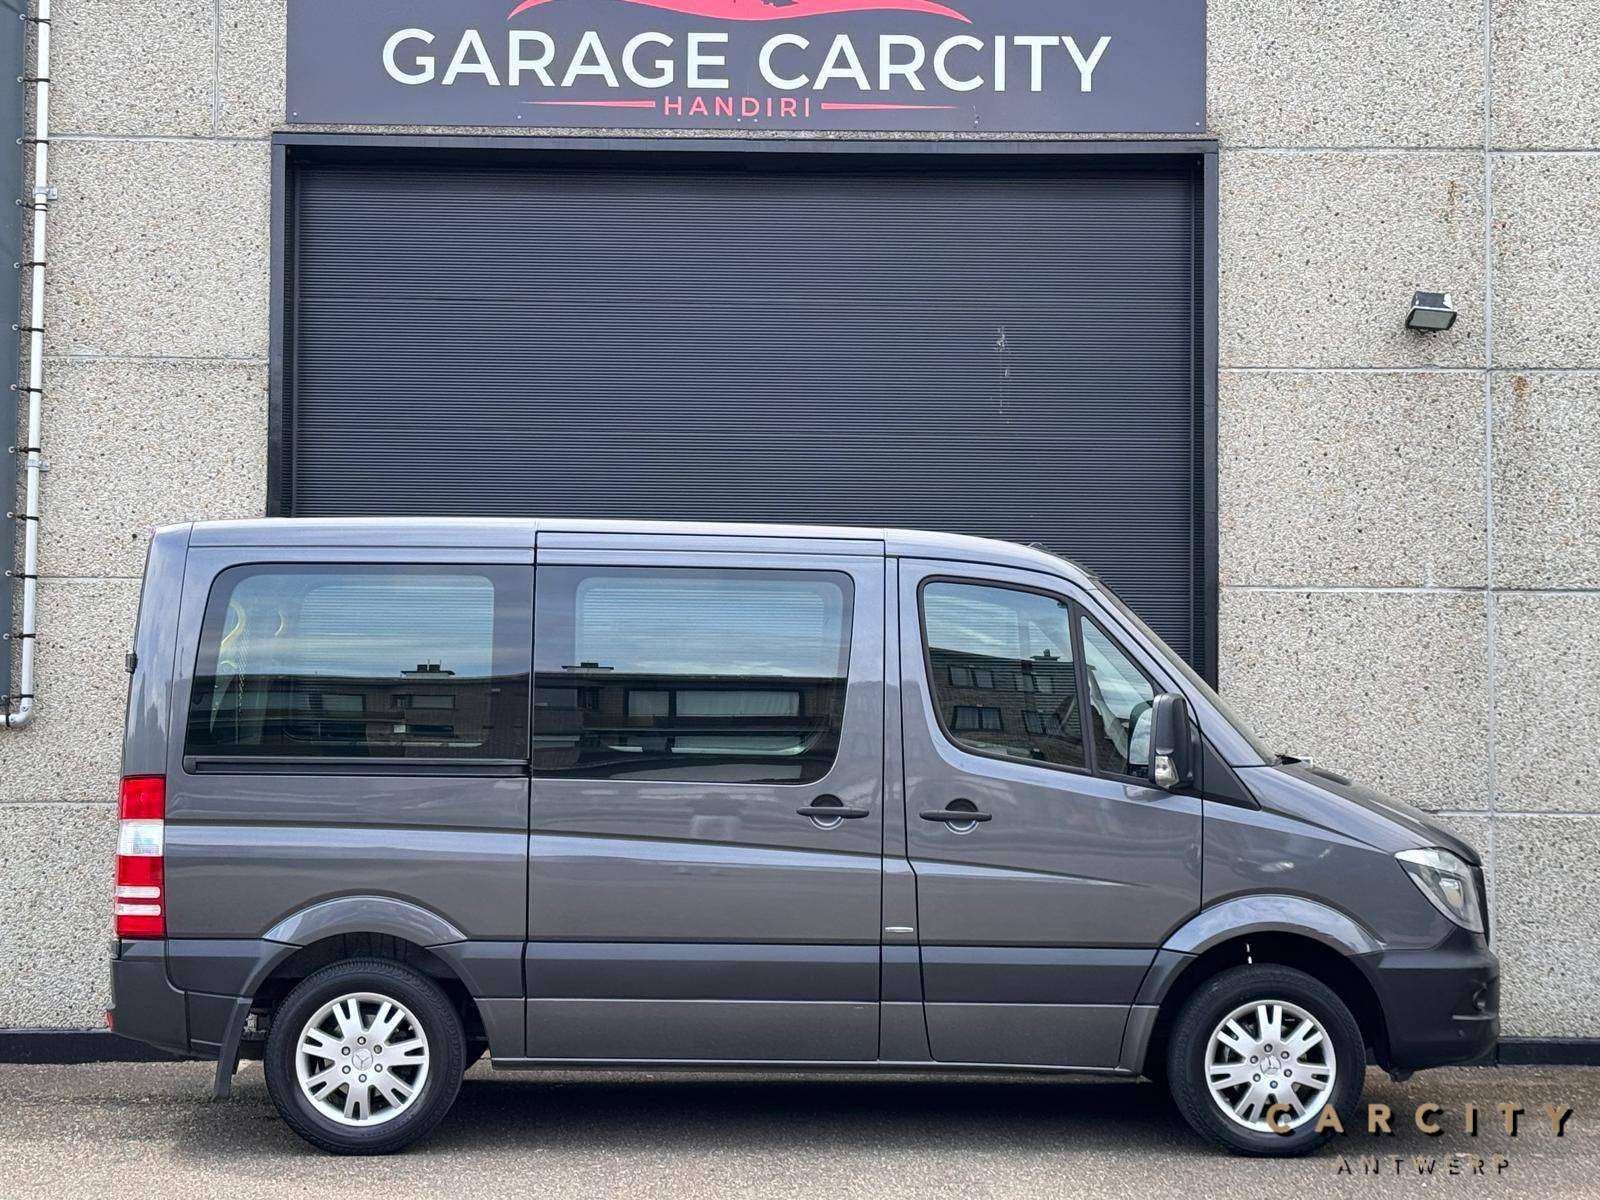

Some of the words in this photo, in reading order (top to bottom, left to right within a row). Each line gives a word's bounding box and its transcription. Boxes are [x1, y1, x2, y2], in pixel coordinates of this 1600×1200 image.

[381, 28, 730, 90] GARAGE
[758, 34, 1112, 93] CARCITY
[664, 95, 812, 118] HANDIRI
